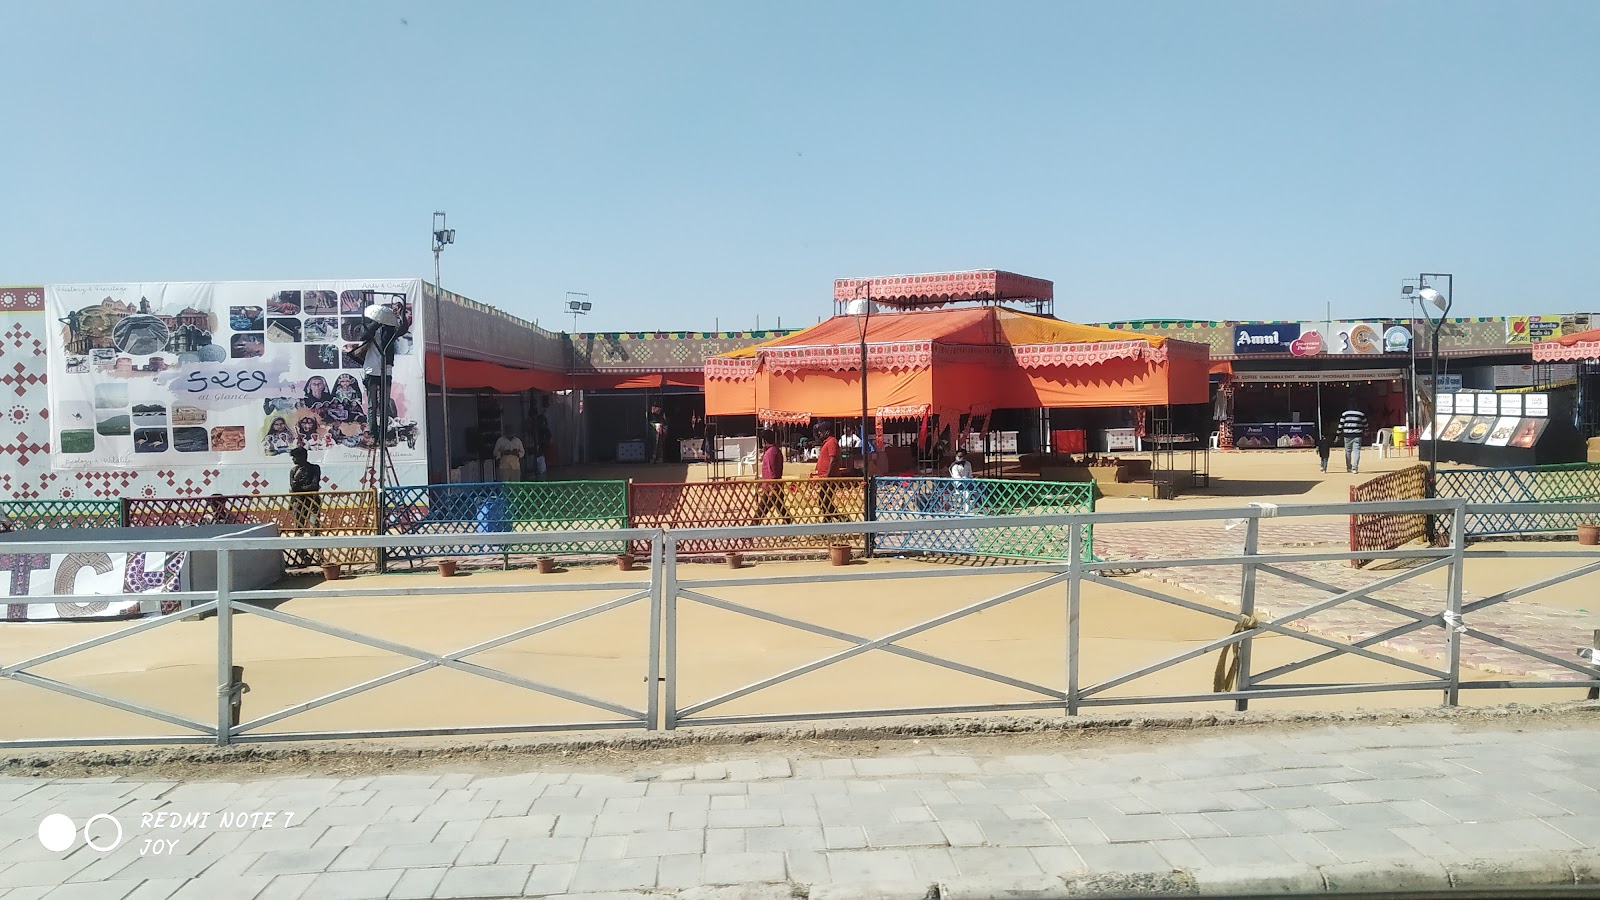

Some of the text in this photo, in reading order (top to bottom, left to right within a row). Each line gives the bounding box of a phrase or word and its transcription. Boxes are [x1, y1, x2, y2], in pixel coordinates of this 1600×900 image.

[57, 287, 87, 295] History
[94, 286, 127, 295] Heritage
[387, 282, 408, 291] Craft
[1236, 331, 1280, 347] Amul
